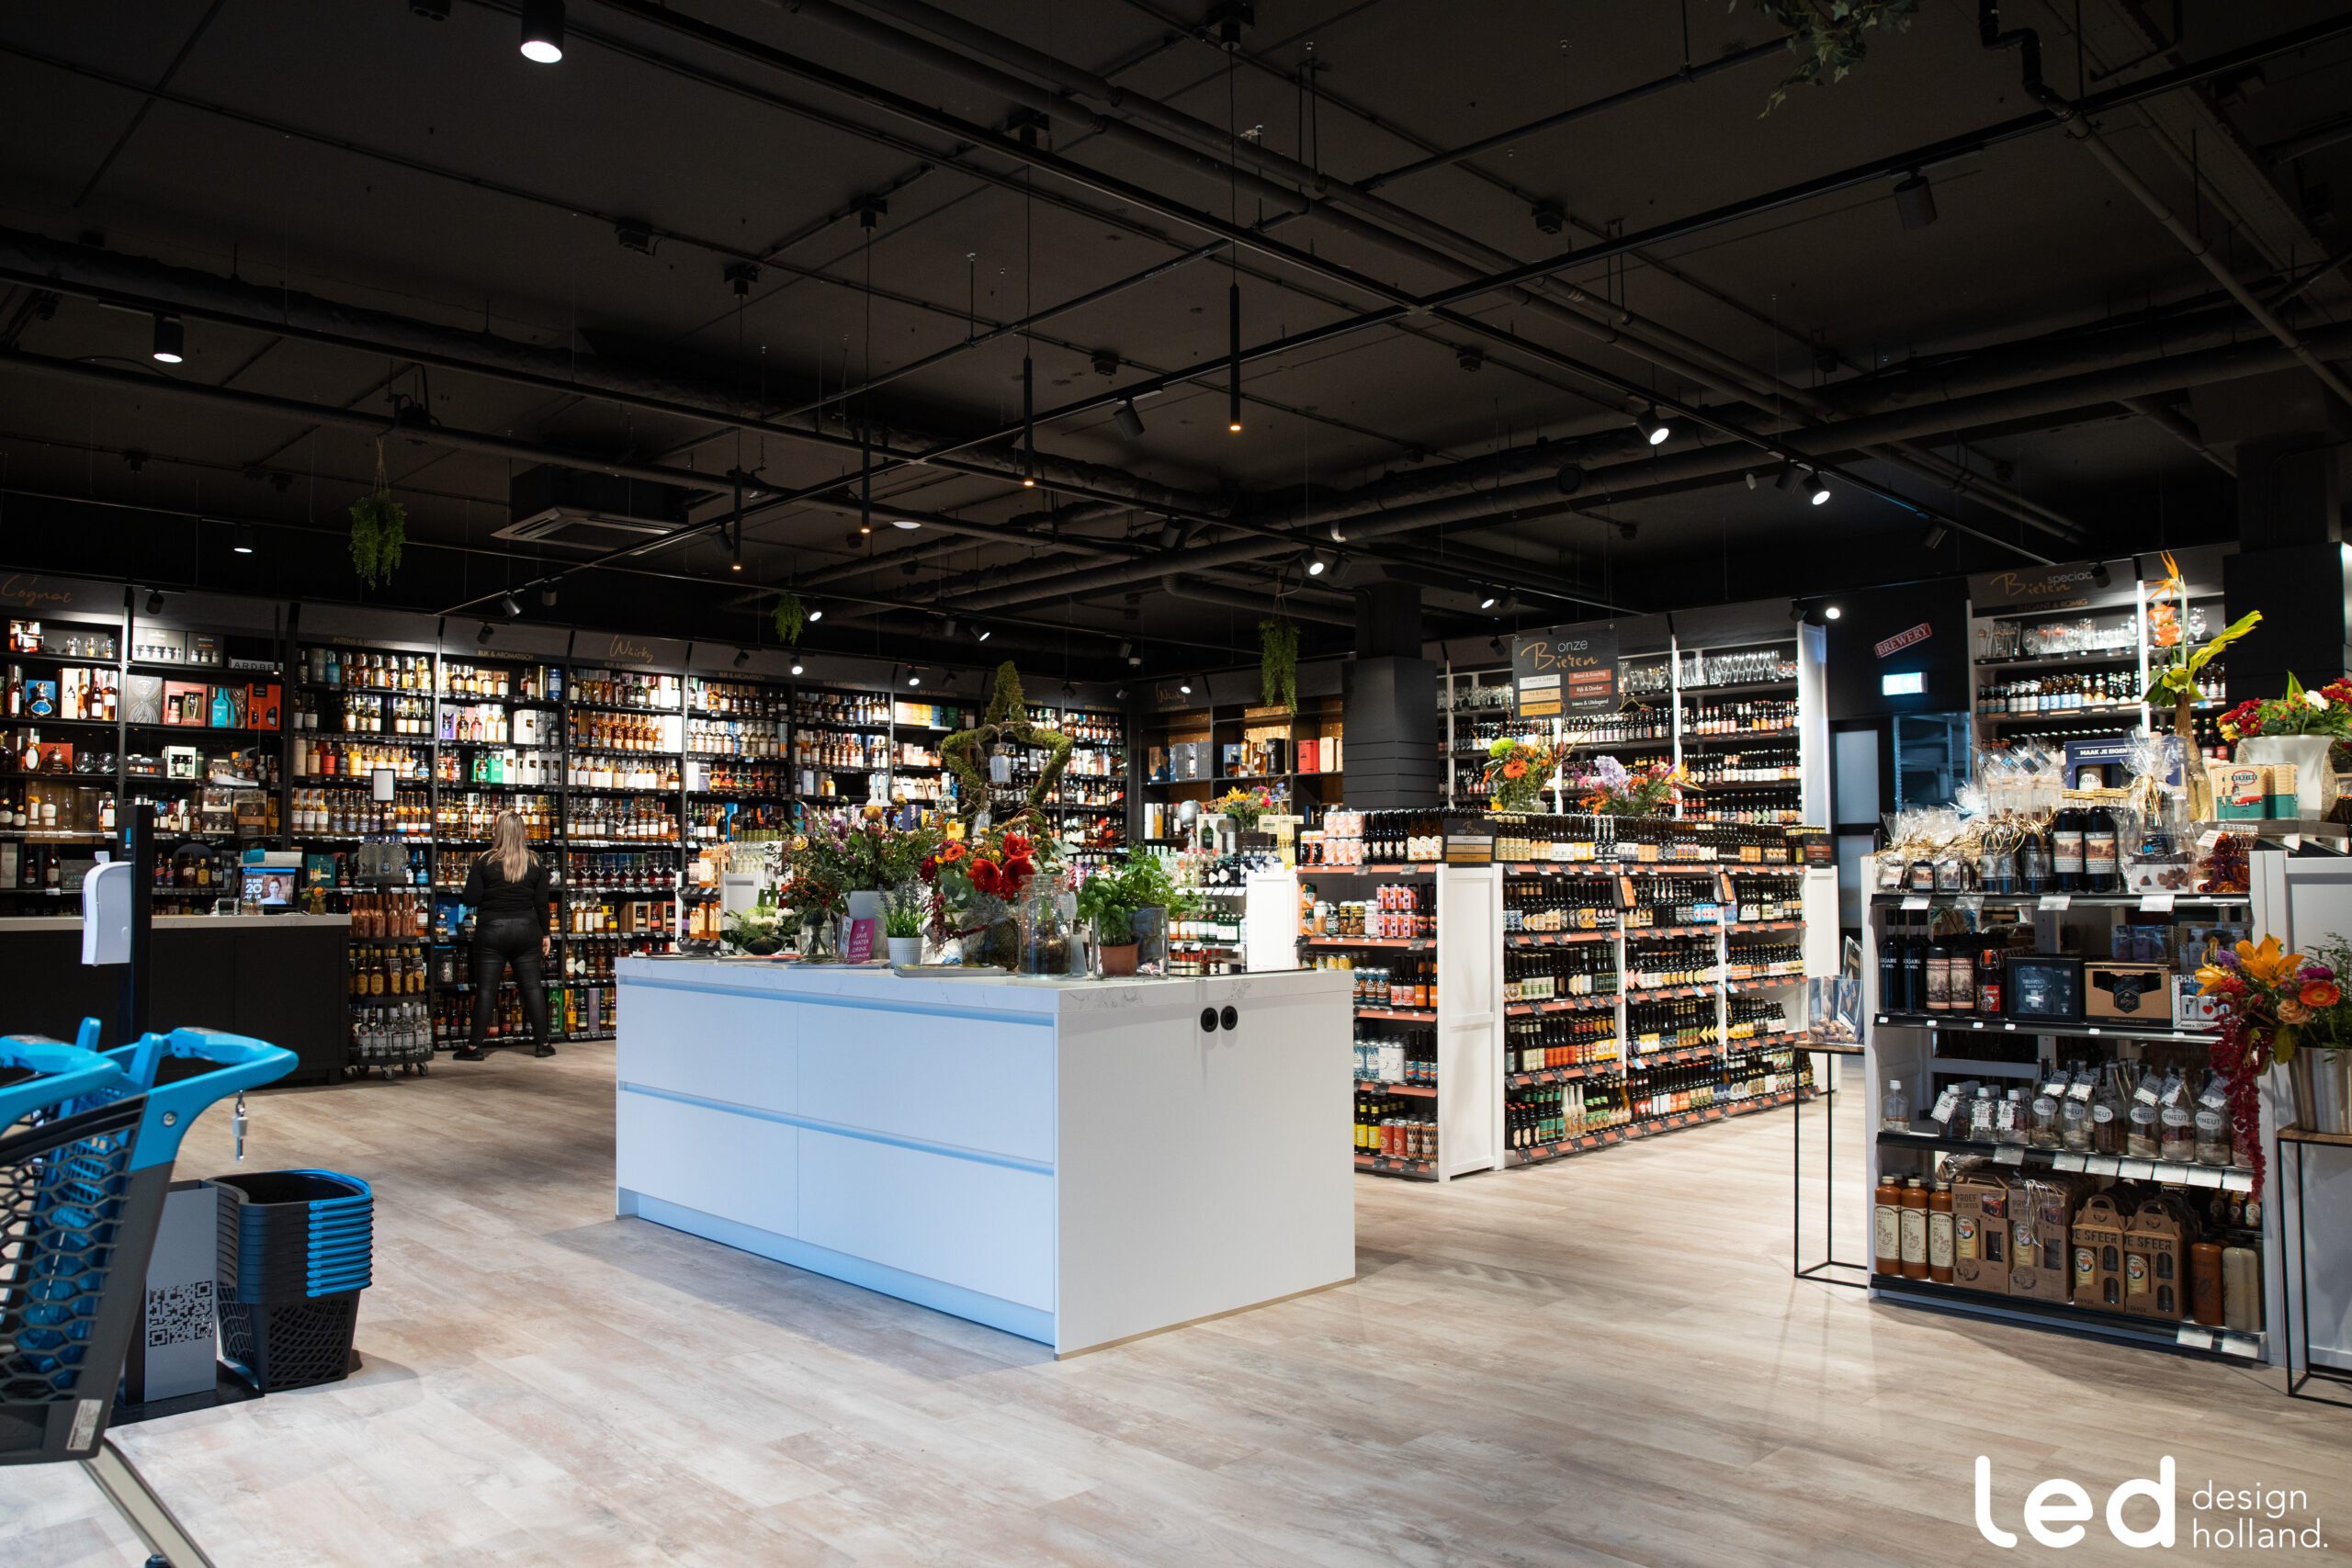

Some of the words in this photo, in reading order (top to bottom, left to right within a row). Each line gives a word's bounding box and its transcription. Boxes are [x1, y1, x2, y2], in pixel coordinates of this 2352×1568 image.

[1, 572, 74, 607] Cognac
[1990, 572, 2071, 596] Bieren
[1557, 639, 1589, 652] onze
[1876, 625, 1928, 656] BREWERY
[609, 633, 654, 663] Whisky
[1521, 641, 1599, 671] Bieren
[234, 661, 283, 671] ARDBE
[2109, 746, 2128, 754] EIGEN
[245, 884, 263, 893] 20
[2132, 1111, 2156, 1120] PINEUT
[2163, 1113, 2188, 1122] PINEUT
[2197, 1117, 2221, 1125] PINEUT
[1955, 1194, 1977, 1202] PROEF
[2084, 1230, 2117, 1244] SFEER
[2137, 1235, 2172, 1250] SFEER
